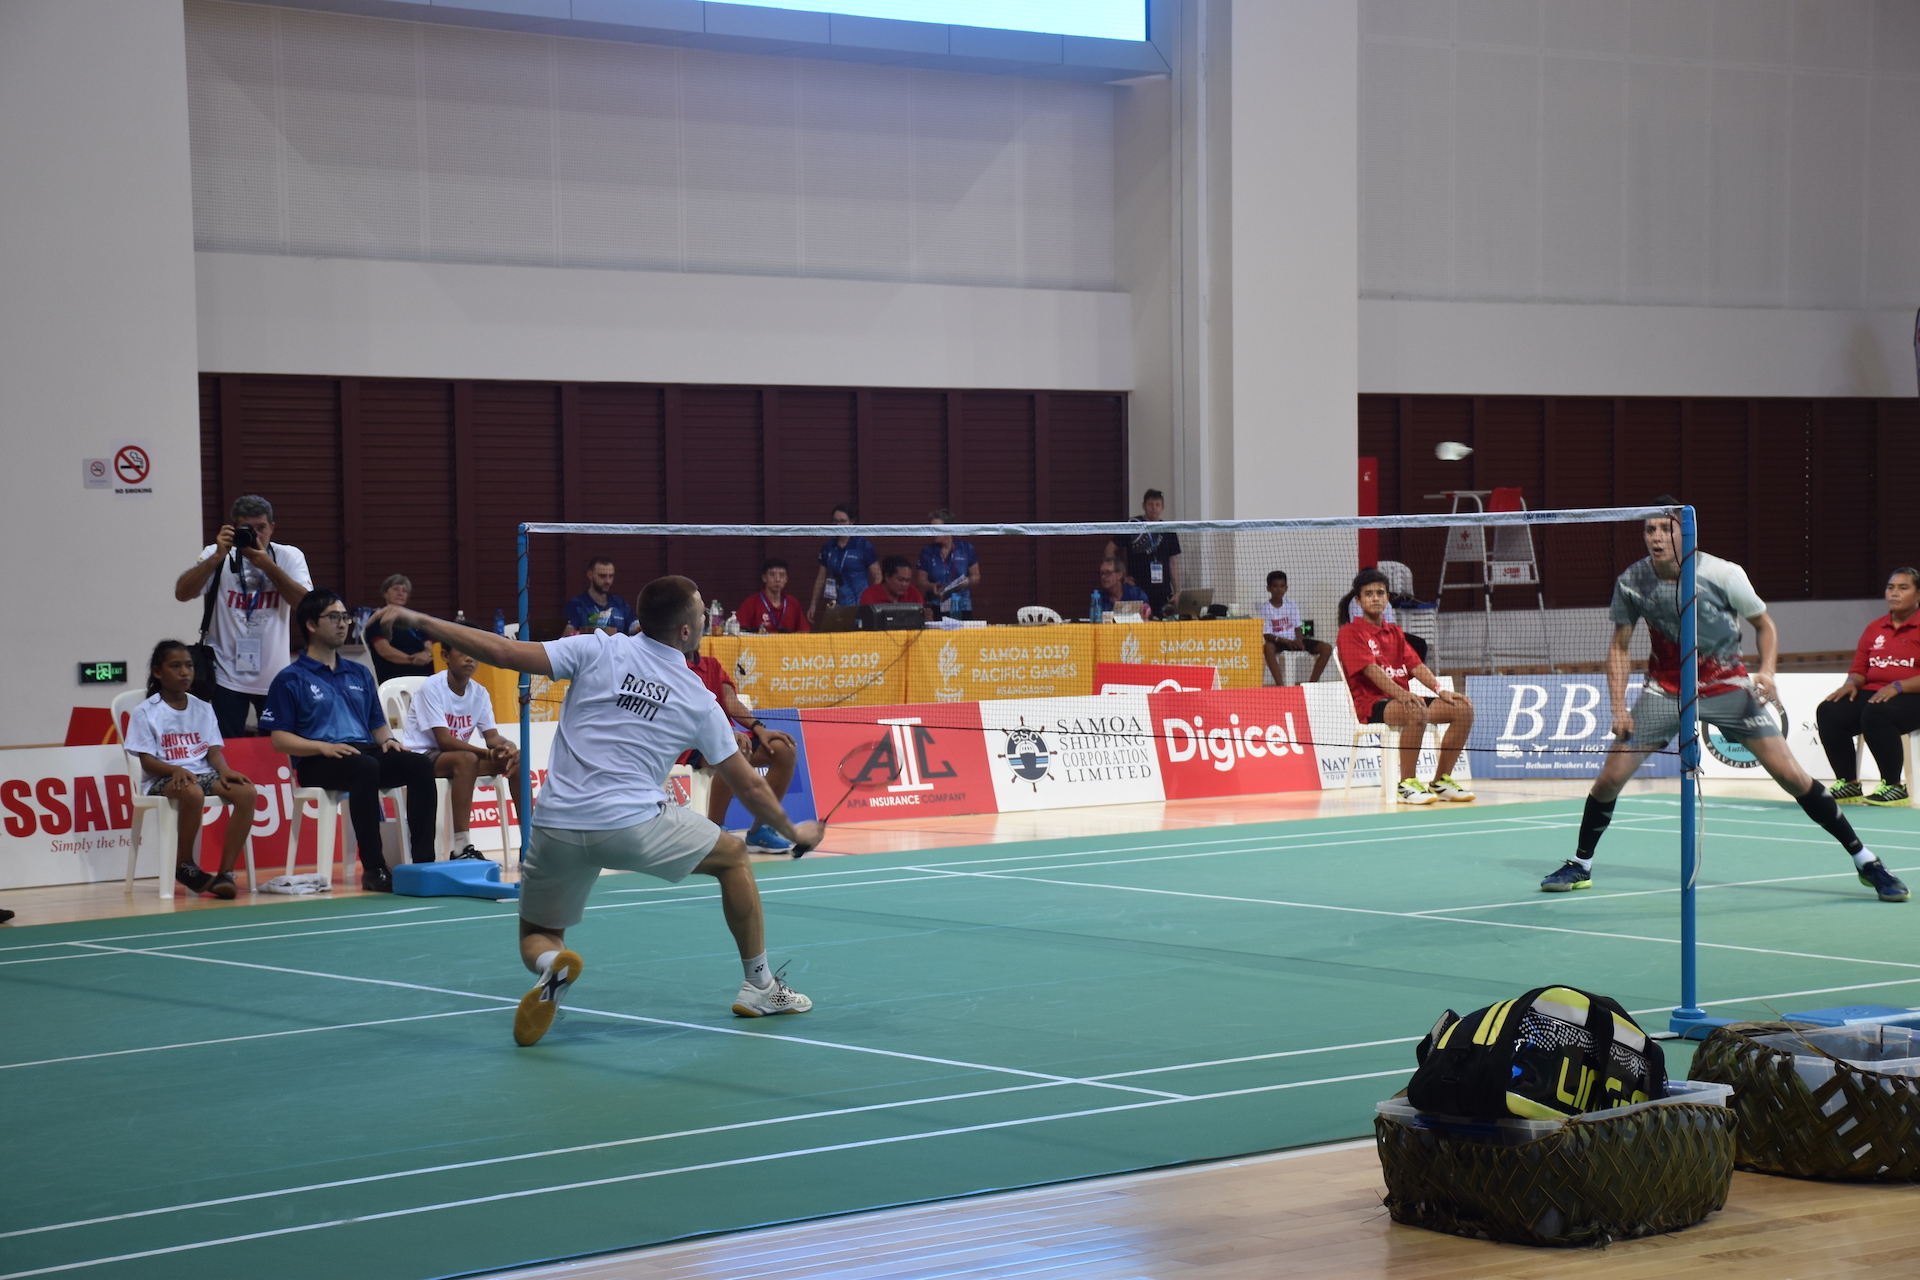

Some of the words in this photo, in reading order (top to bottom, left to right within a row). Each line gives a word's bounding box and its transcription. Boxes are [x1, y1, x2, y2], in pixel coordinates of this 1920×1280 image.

[125, 487, 152, 495] SMOKING
[980, 646, 1030, 662] SAMOA
[1033, 645, 1071, 661] 2019
[1160, 639, 1206, 654] SAMOA
[1208, 637, 1243, 653] 2019
[781, 655, 835, 671] SAMOA
[840, 652, 880, 669] 2019
[1205, 656, 1250, 670] GAMES
[1869, 655, 1915, 668] Digicel
[770, 675, 830, 691] PACIFIC
[834, 671, 885, 689] GAMES
[972, 666, 1026, 682] PACIFIC
[1030, 663, 1078, 679] GAMES
[620, 672, 671, 704] ROSSI
[996, 685, 1055, 696] #SAMOA2019
[616, 693, 659, 721] TAHITI
[1057, 716, 1143, 735] SAMOA
[161, 732, 202, 748] SHUTTLE
[1011, 728, 1039, 745] SSC
[1059, 734, 1146, 750] SHIPPING
[1163, 712, 1304, 772] Digicel
[163, 746, 190, 761] TIME
[1062, 748, 1149, 768] CORPORATION
[1578, 744, 1606, 756] 1992
[1066, 765, 1151, 783] LIMITED
[1525, 761, 1552, 770] Betham
[1553, 761, 1582, 770] Brothers
[0, 774, 134, 838] SSAB
[847, 798, 867, 808] APIA
[869, 795, 920, 808] INSURANCE
[922, 792, 966, 804] COMPANY
[51, 837, 93, 854] Simply
[96, 836, 115, 849] the
[119, 834, 143, 848] bet
